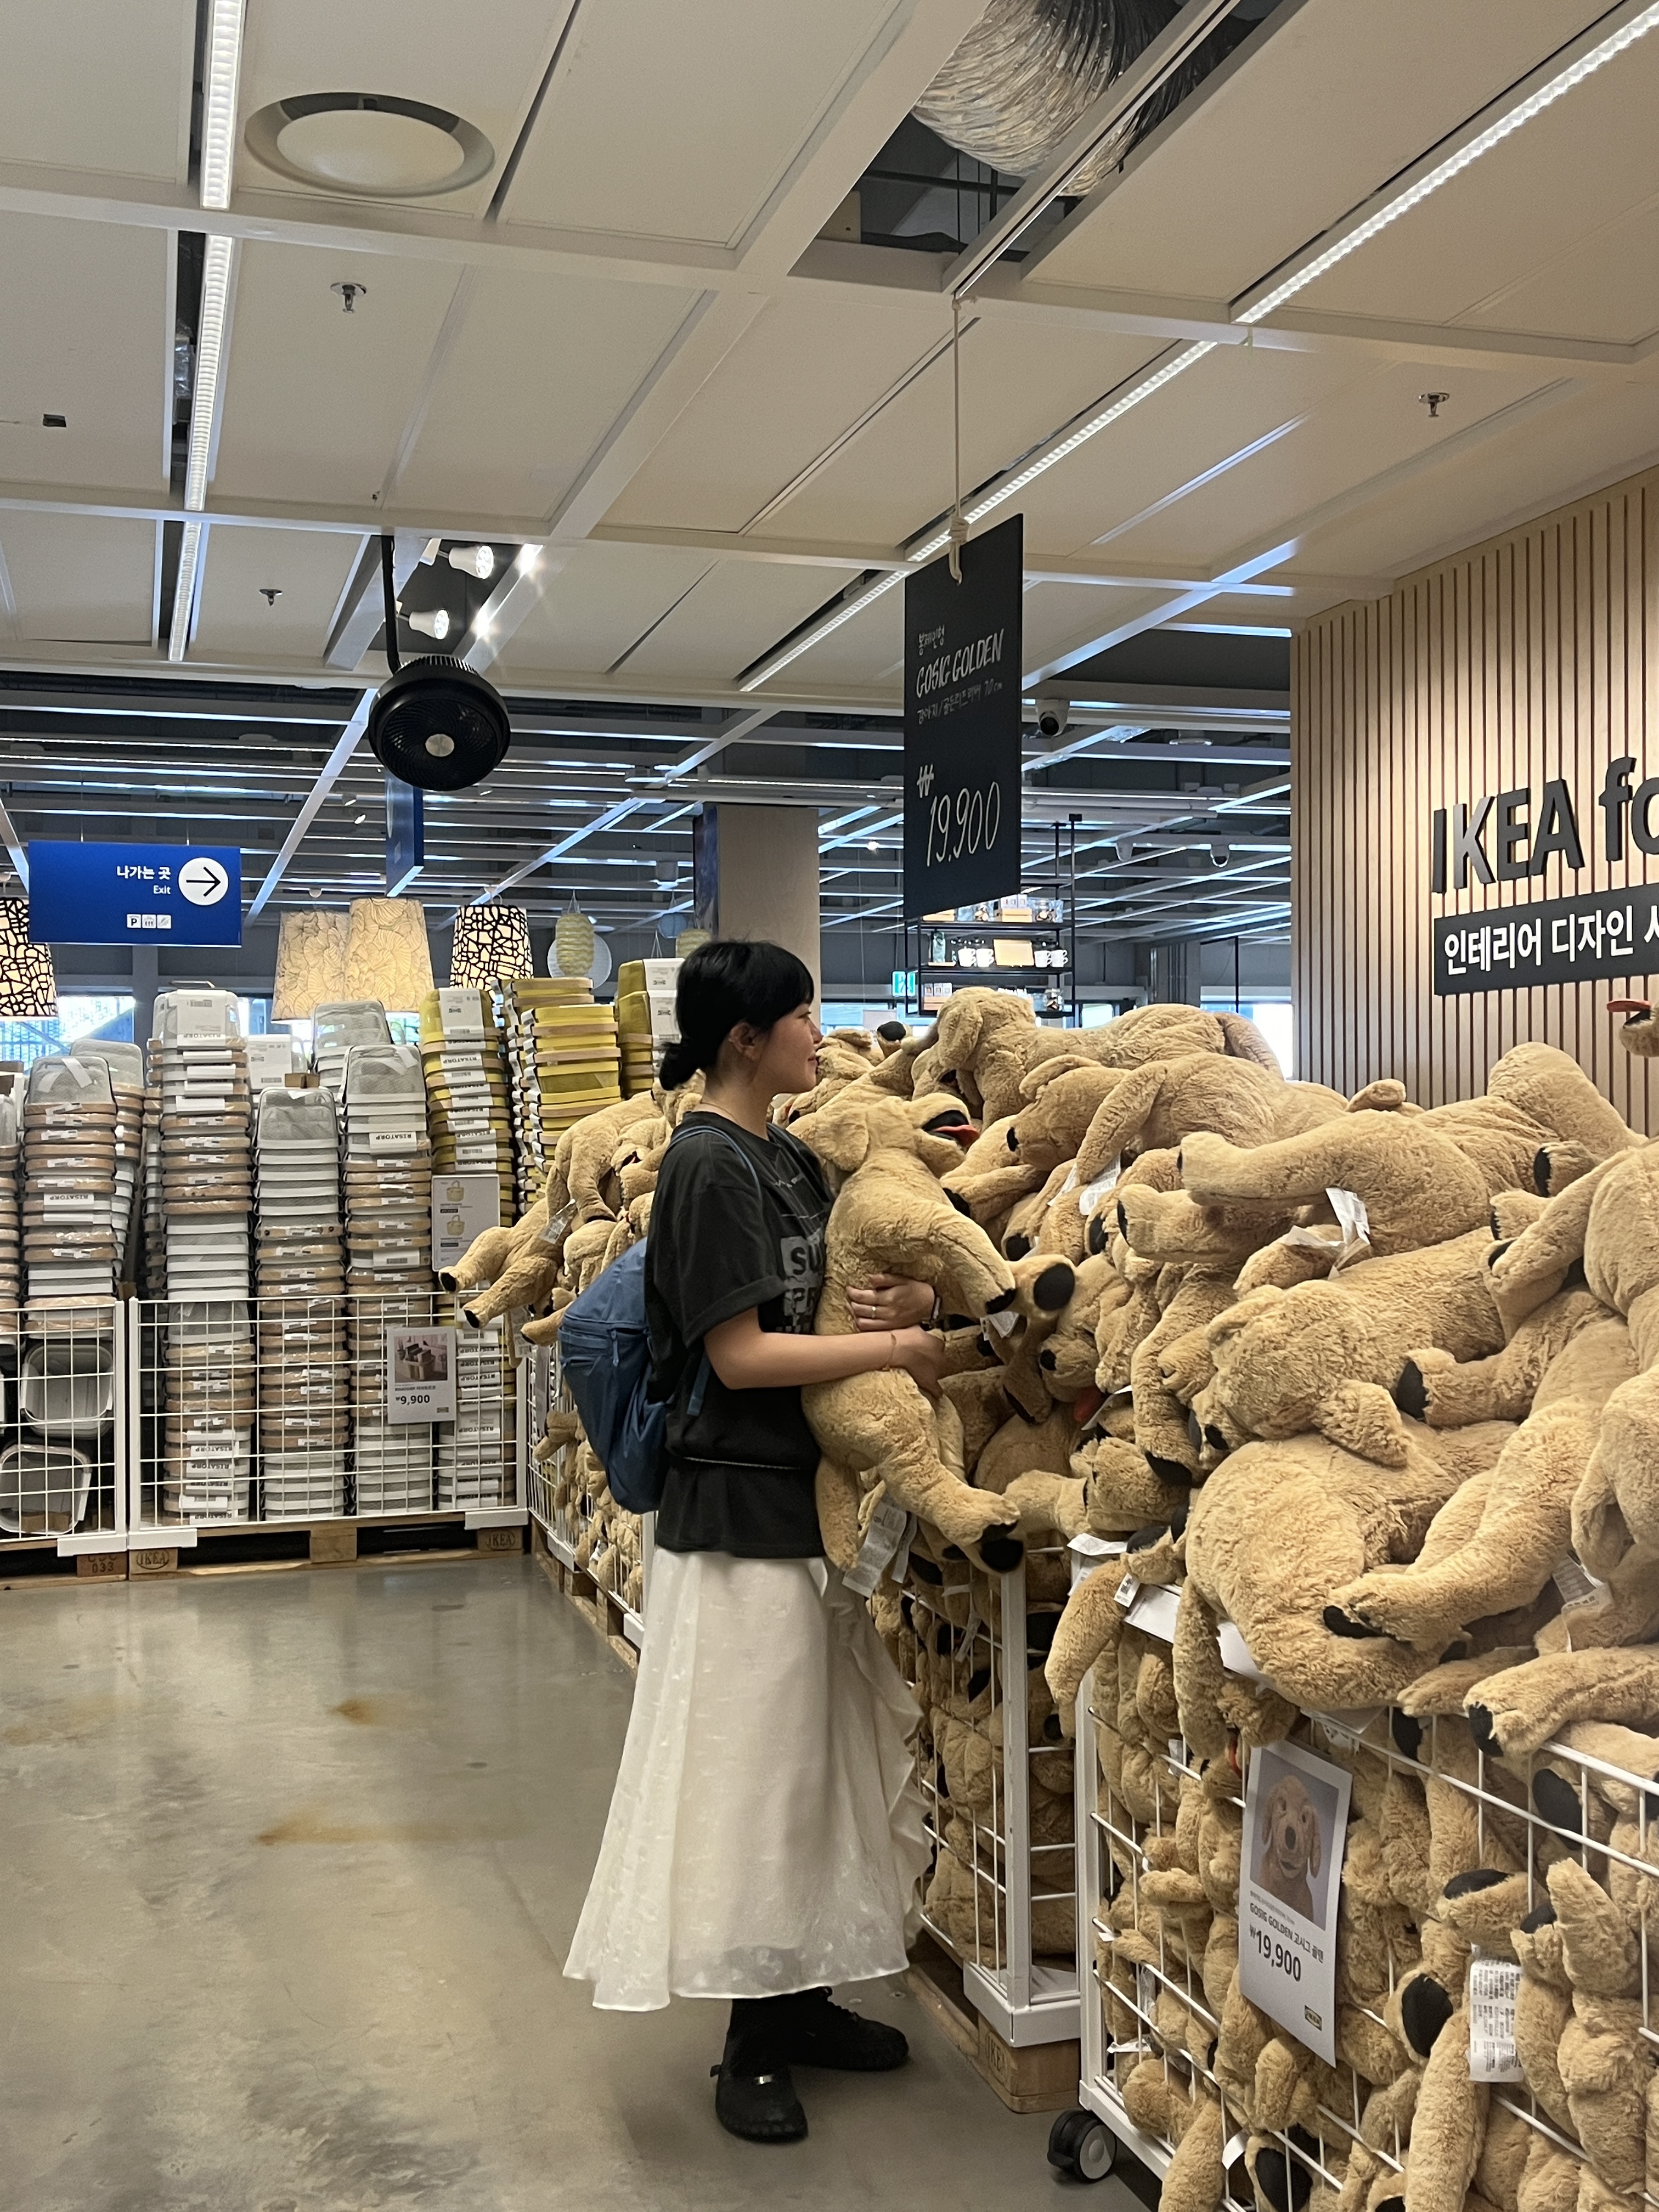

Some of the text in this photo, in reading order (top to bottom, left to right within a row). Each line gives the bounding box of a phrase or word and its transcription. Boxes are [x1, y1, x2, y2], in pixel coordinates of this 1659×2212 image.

[918, 624, 945, 656] 봉제인형
[916, 628, 1005, 698] GOSIG GOLDEN
[1432, 777, 1586, 894] IKEA
[117, 865, 171, 880] 나가는 곳
[153, 885, 171, 894] Exit
[1444, 918, 1542, 975] 인테리어
[1551, 905, 1634, 962] 디자인
[92, 1562, 114, 1573] 033
[140, 1551, 166, 1565] IKEA
[1268, 1915, 1293, 1941] GOLDEN
